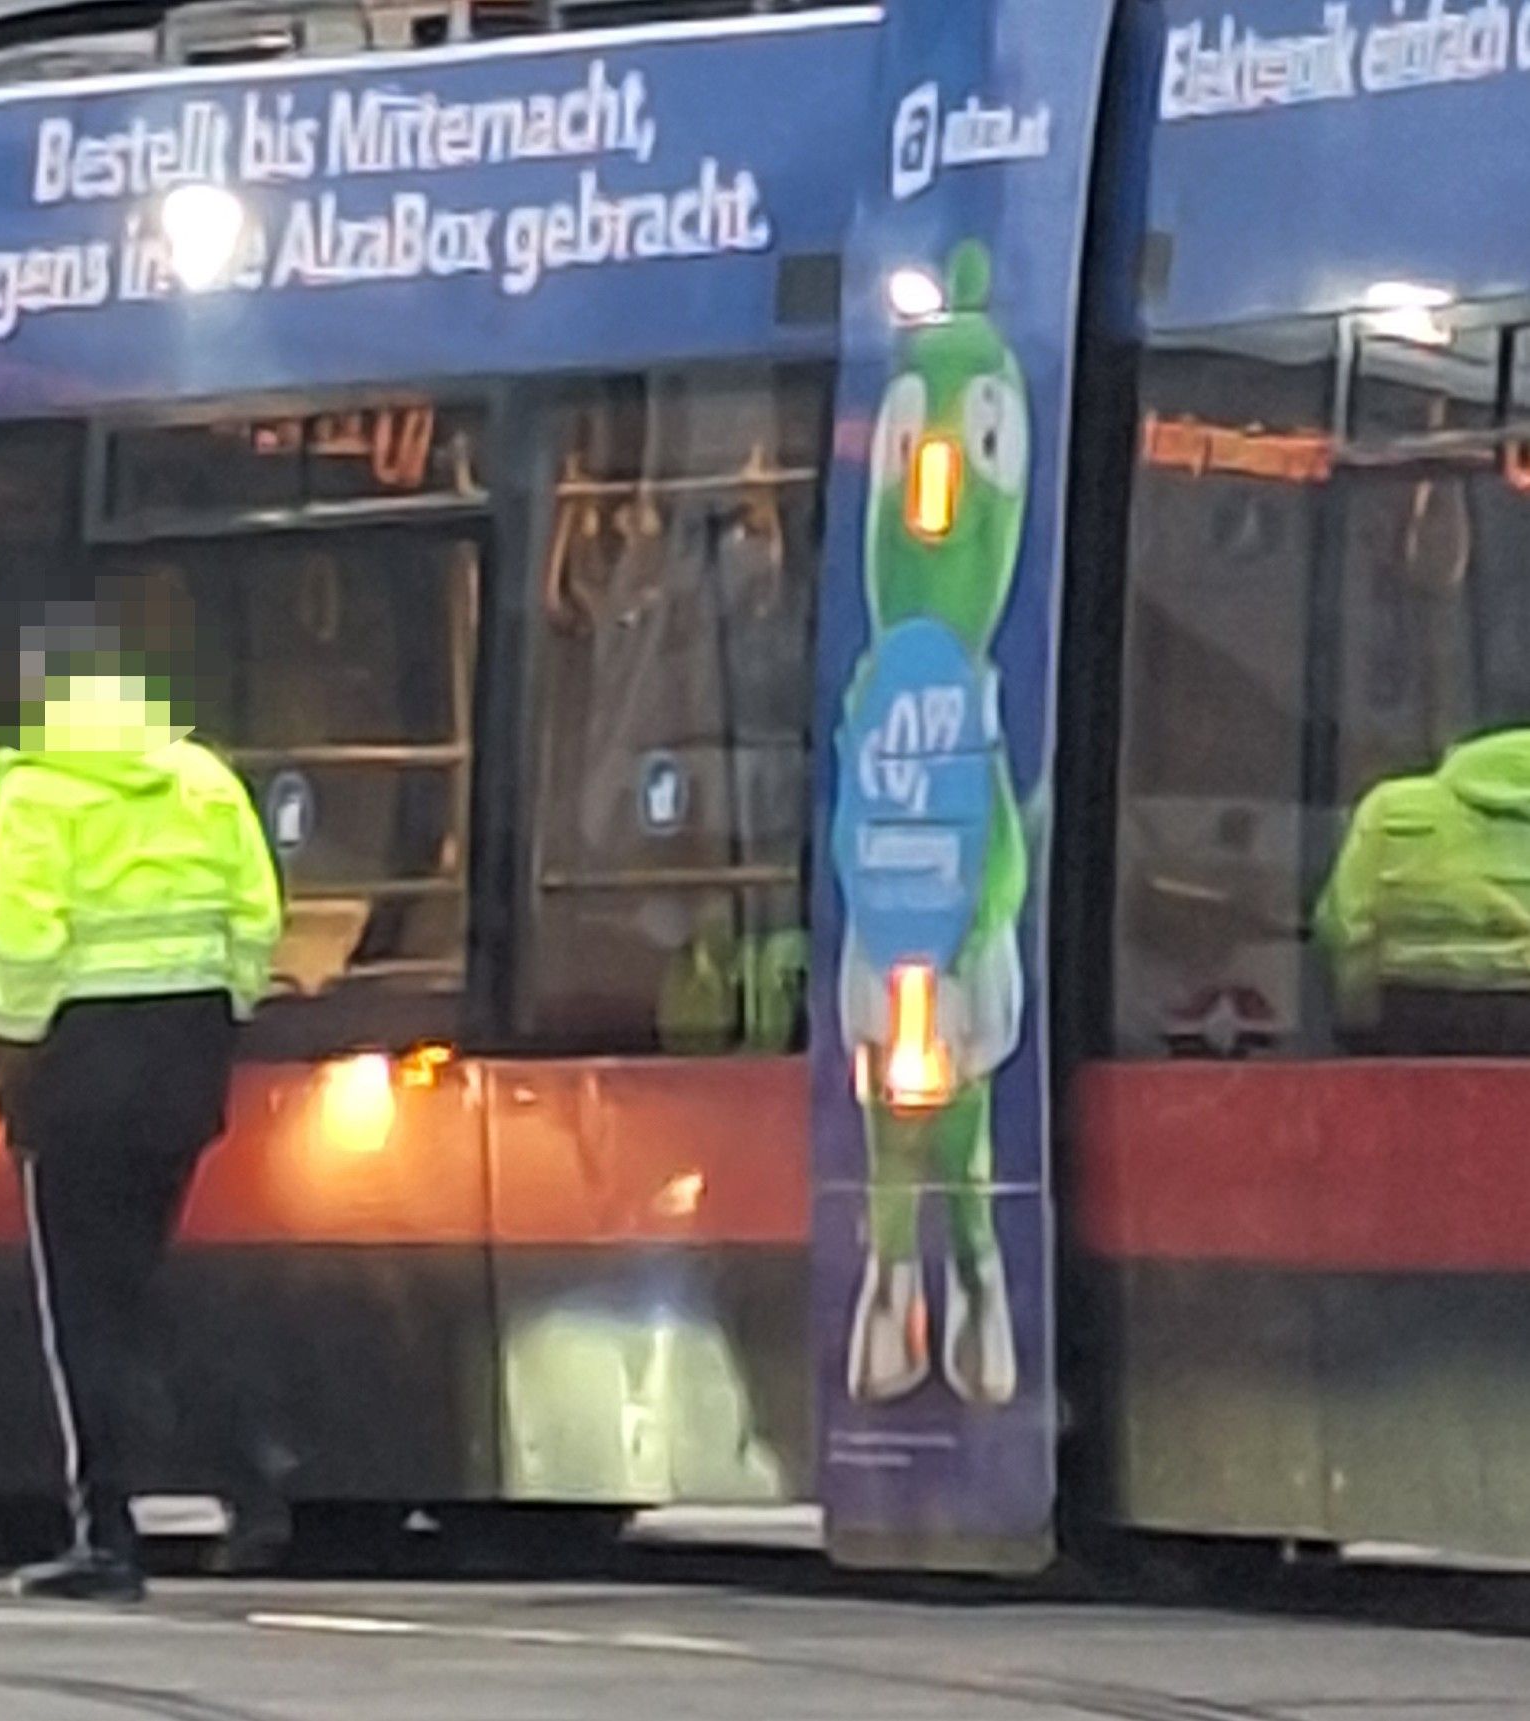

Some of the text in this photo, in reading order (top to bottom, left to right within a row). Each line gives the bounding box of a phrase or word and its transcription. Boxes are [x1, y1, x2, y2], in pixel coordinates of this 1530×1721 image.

[33, 57, 656, 204] Bestellt bis Mitternacht,
[271, 190, 497, 290] AlzaBox
[501, 156, 768, 295] gebracht.
